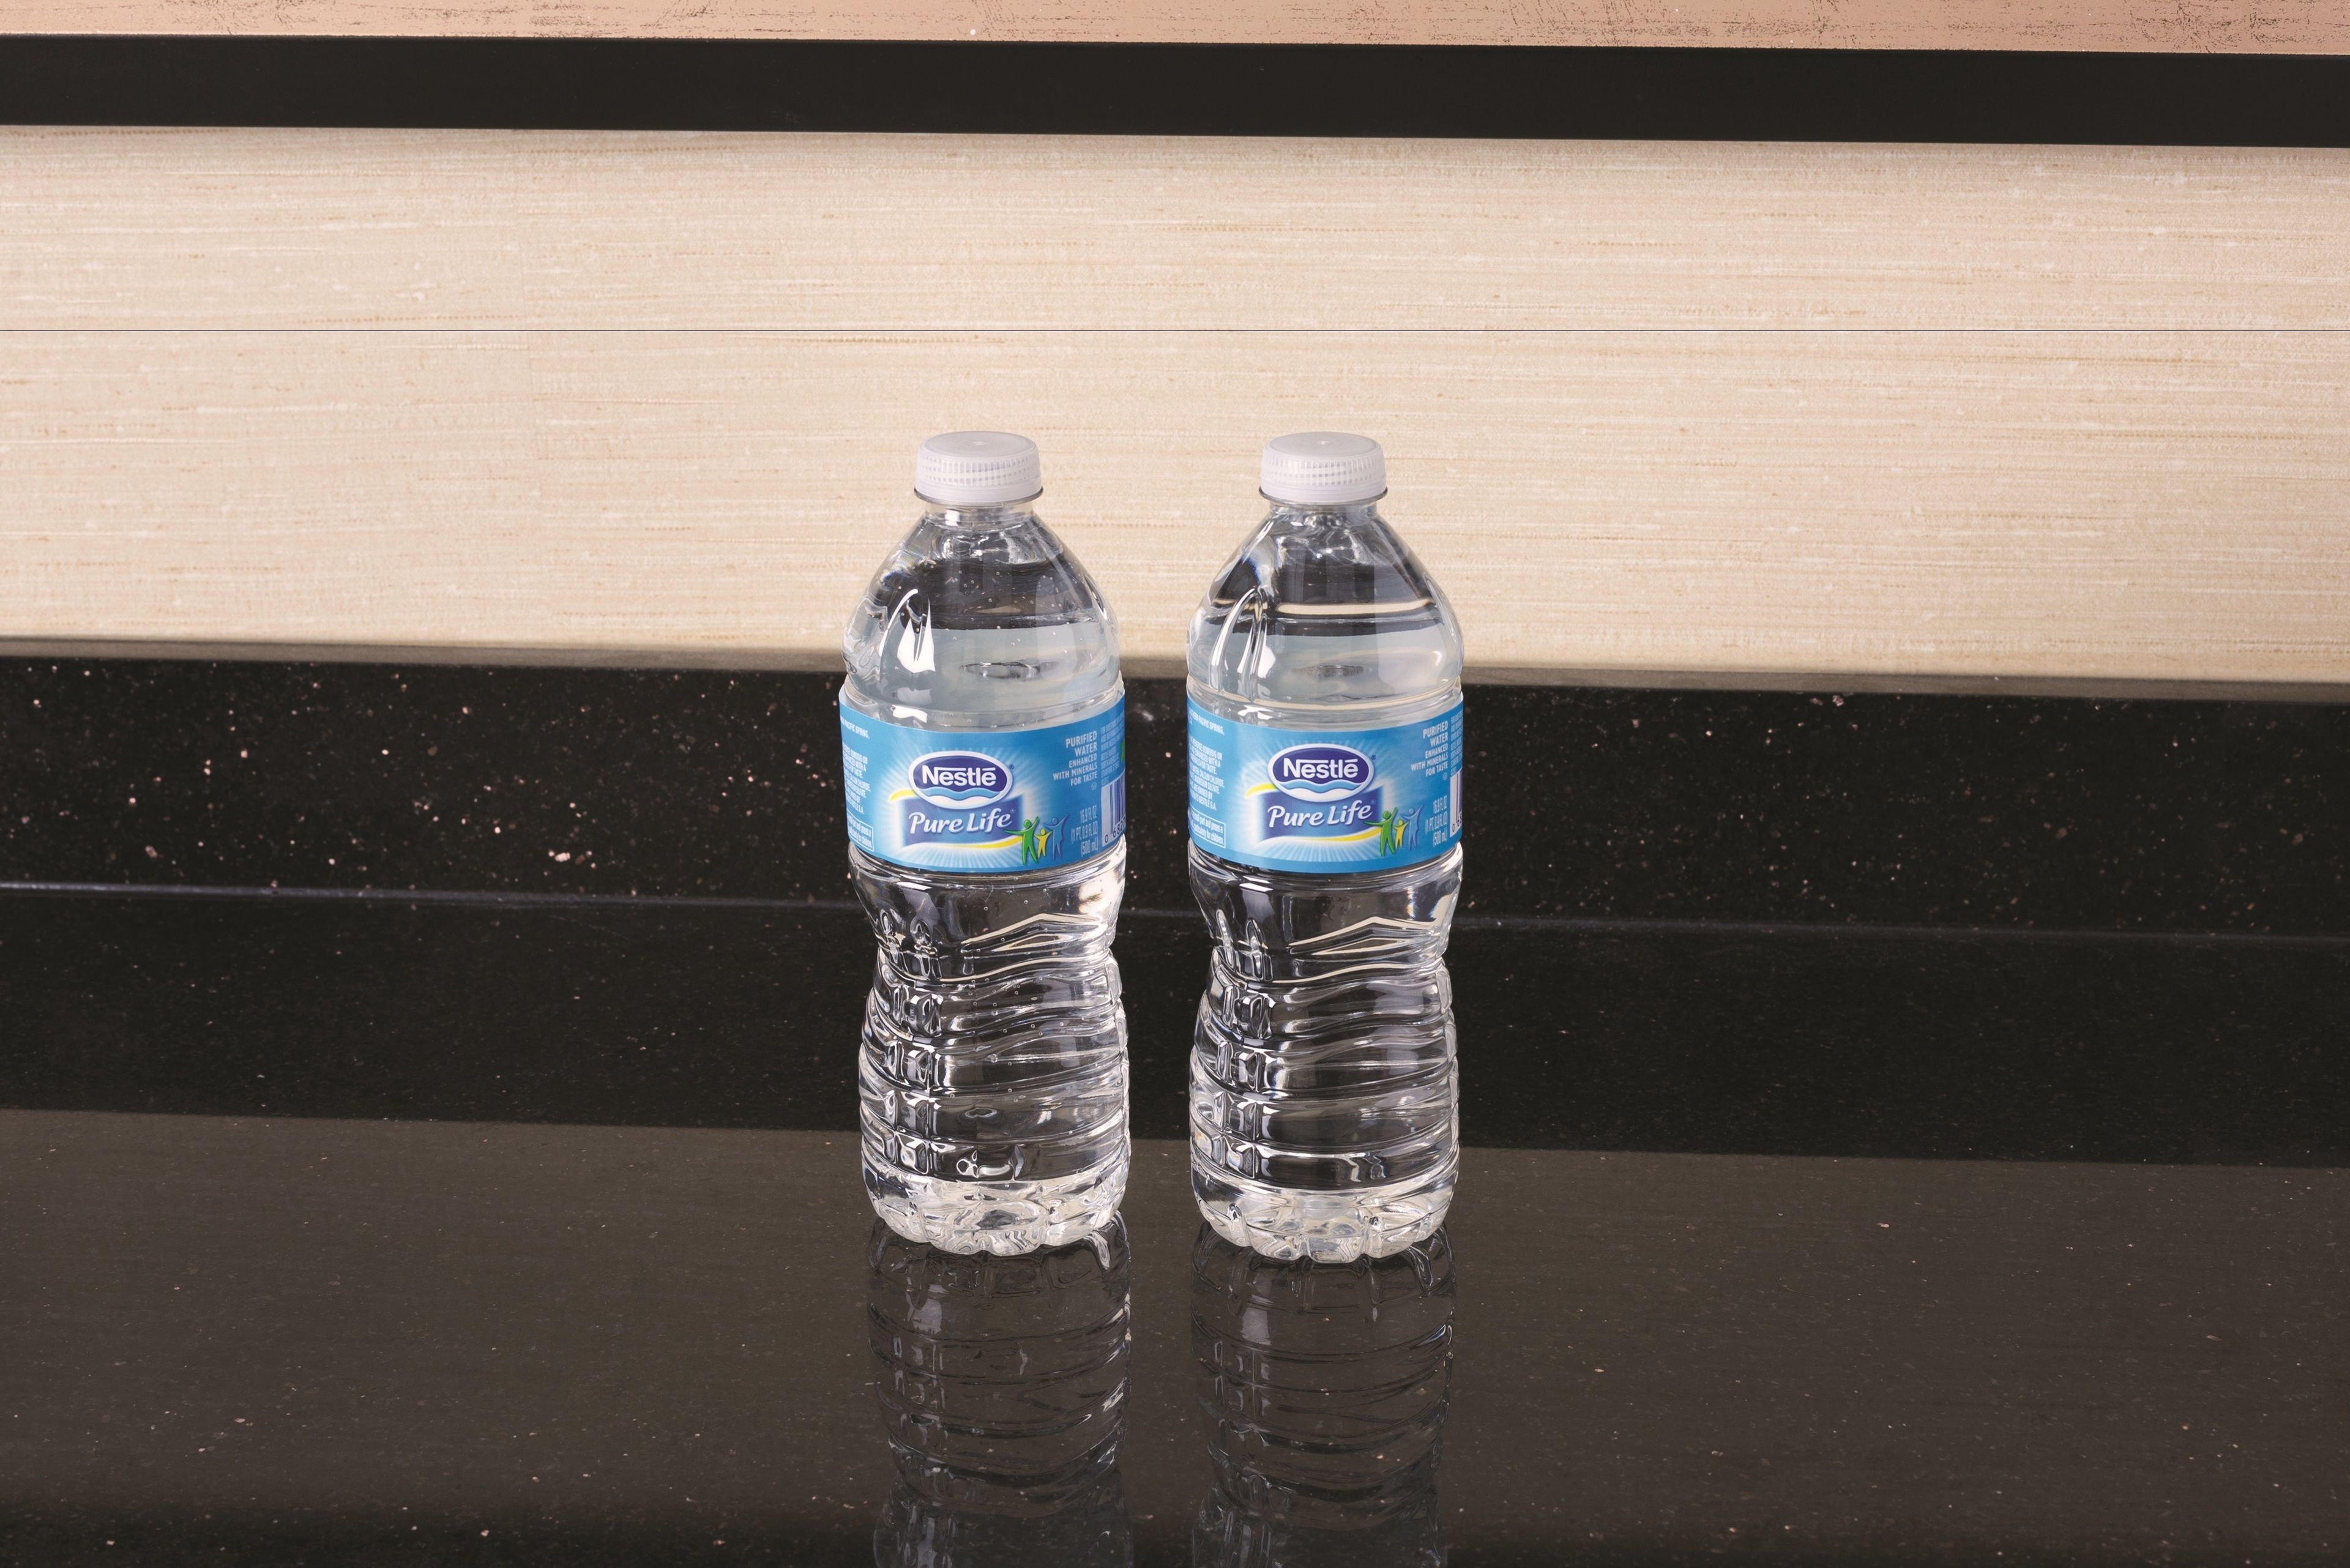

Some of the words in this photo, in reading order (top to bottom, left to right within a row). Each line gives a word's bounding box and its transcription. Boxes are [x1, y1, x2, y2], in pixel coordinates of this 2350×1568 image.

[1423, 720, 1448, 739] PURIFIED
[1065, 731, 1097, 748] PURIFIED
[1430, 731, 1448, 747] WATER
[1075, 742, 1097, 756] WATER
[1425, 743, 1448, 759] ENHANCED
[1069, 753, 1097, 768] ENHANCED
[1411, 761, 1426, 772] WITH
[1427, 752, 1448, 767] MINERALS
[1053, 771, 1070, 781] WITH
[1071, 762, 1097, 777] MINERALS
[1426, 767, 1436, 777] FOR
[1436, 761, 1448, 773] TASTE
[1070, 777, 1082, 786] FOR
[1083, 771, 1097, 782] TASTE
[909, 812, 965, 834] Pure
[966, 808, 1012, 833] Life
[1267, 805, 1325, 827] Pure
[1327, 800, 1373, 825] Life
[1105, 834, 1109, 843] 0
